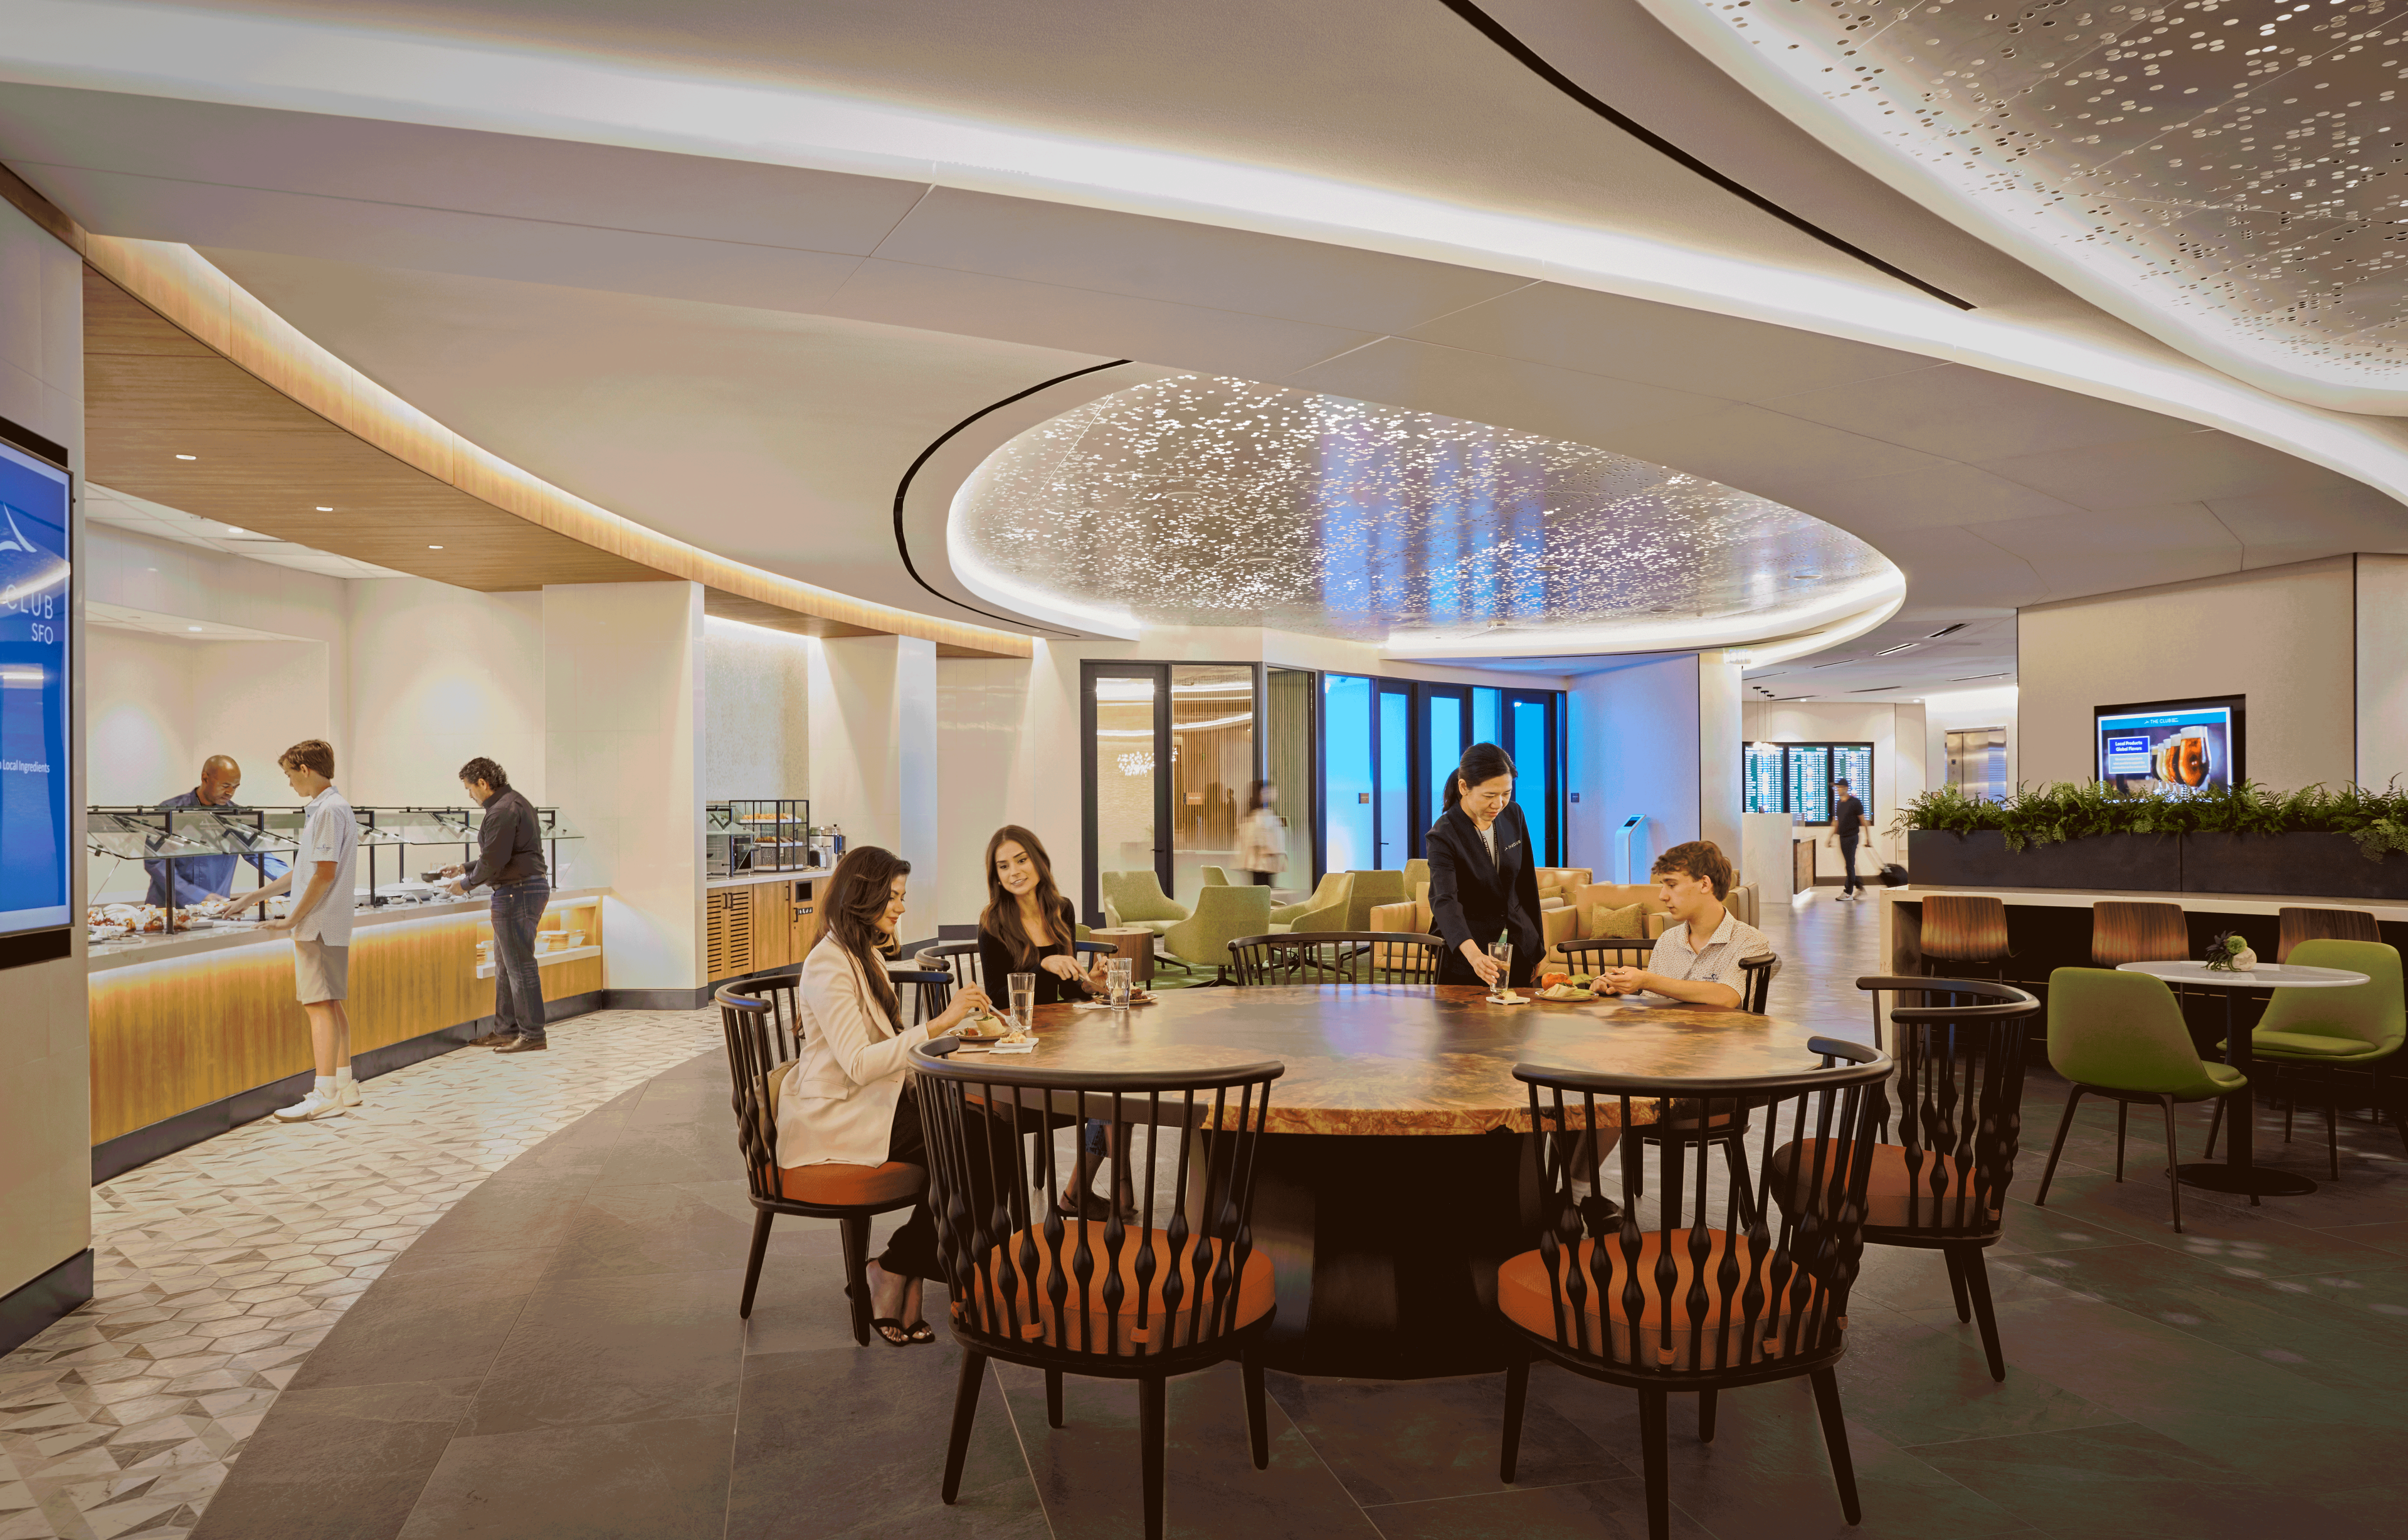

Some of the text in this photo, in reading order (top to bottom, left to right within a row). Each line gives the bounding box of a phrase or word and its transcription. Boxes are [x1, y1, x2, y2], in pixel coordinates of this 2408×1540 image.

[6, 584, 53, 620] CLUB
[32, 623, 53, 645] SFO
[3, 759, 18, 771] Local
[19, 760, 50, 774] Ingredients
